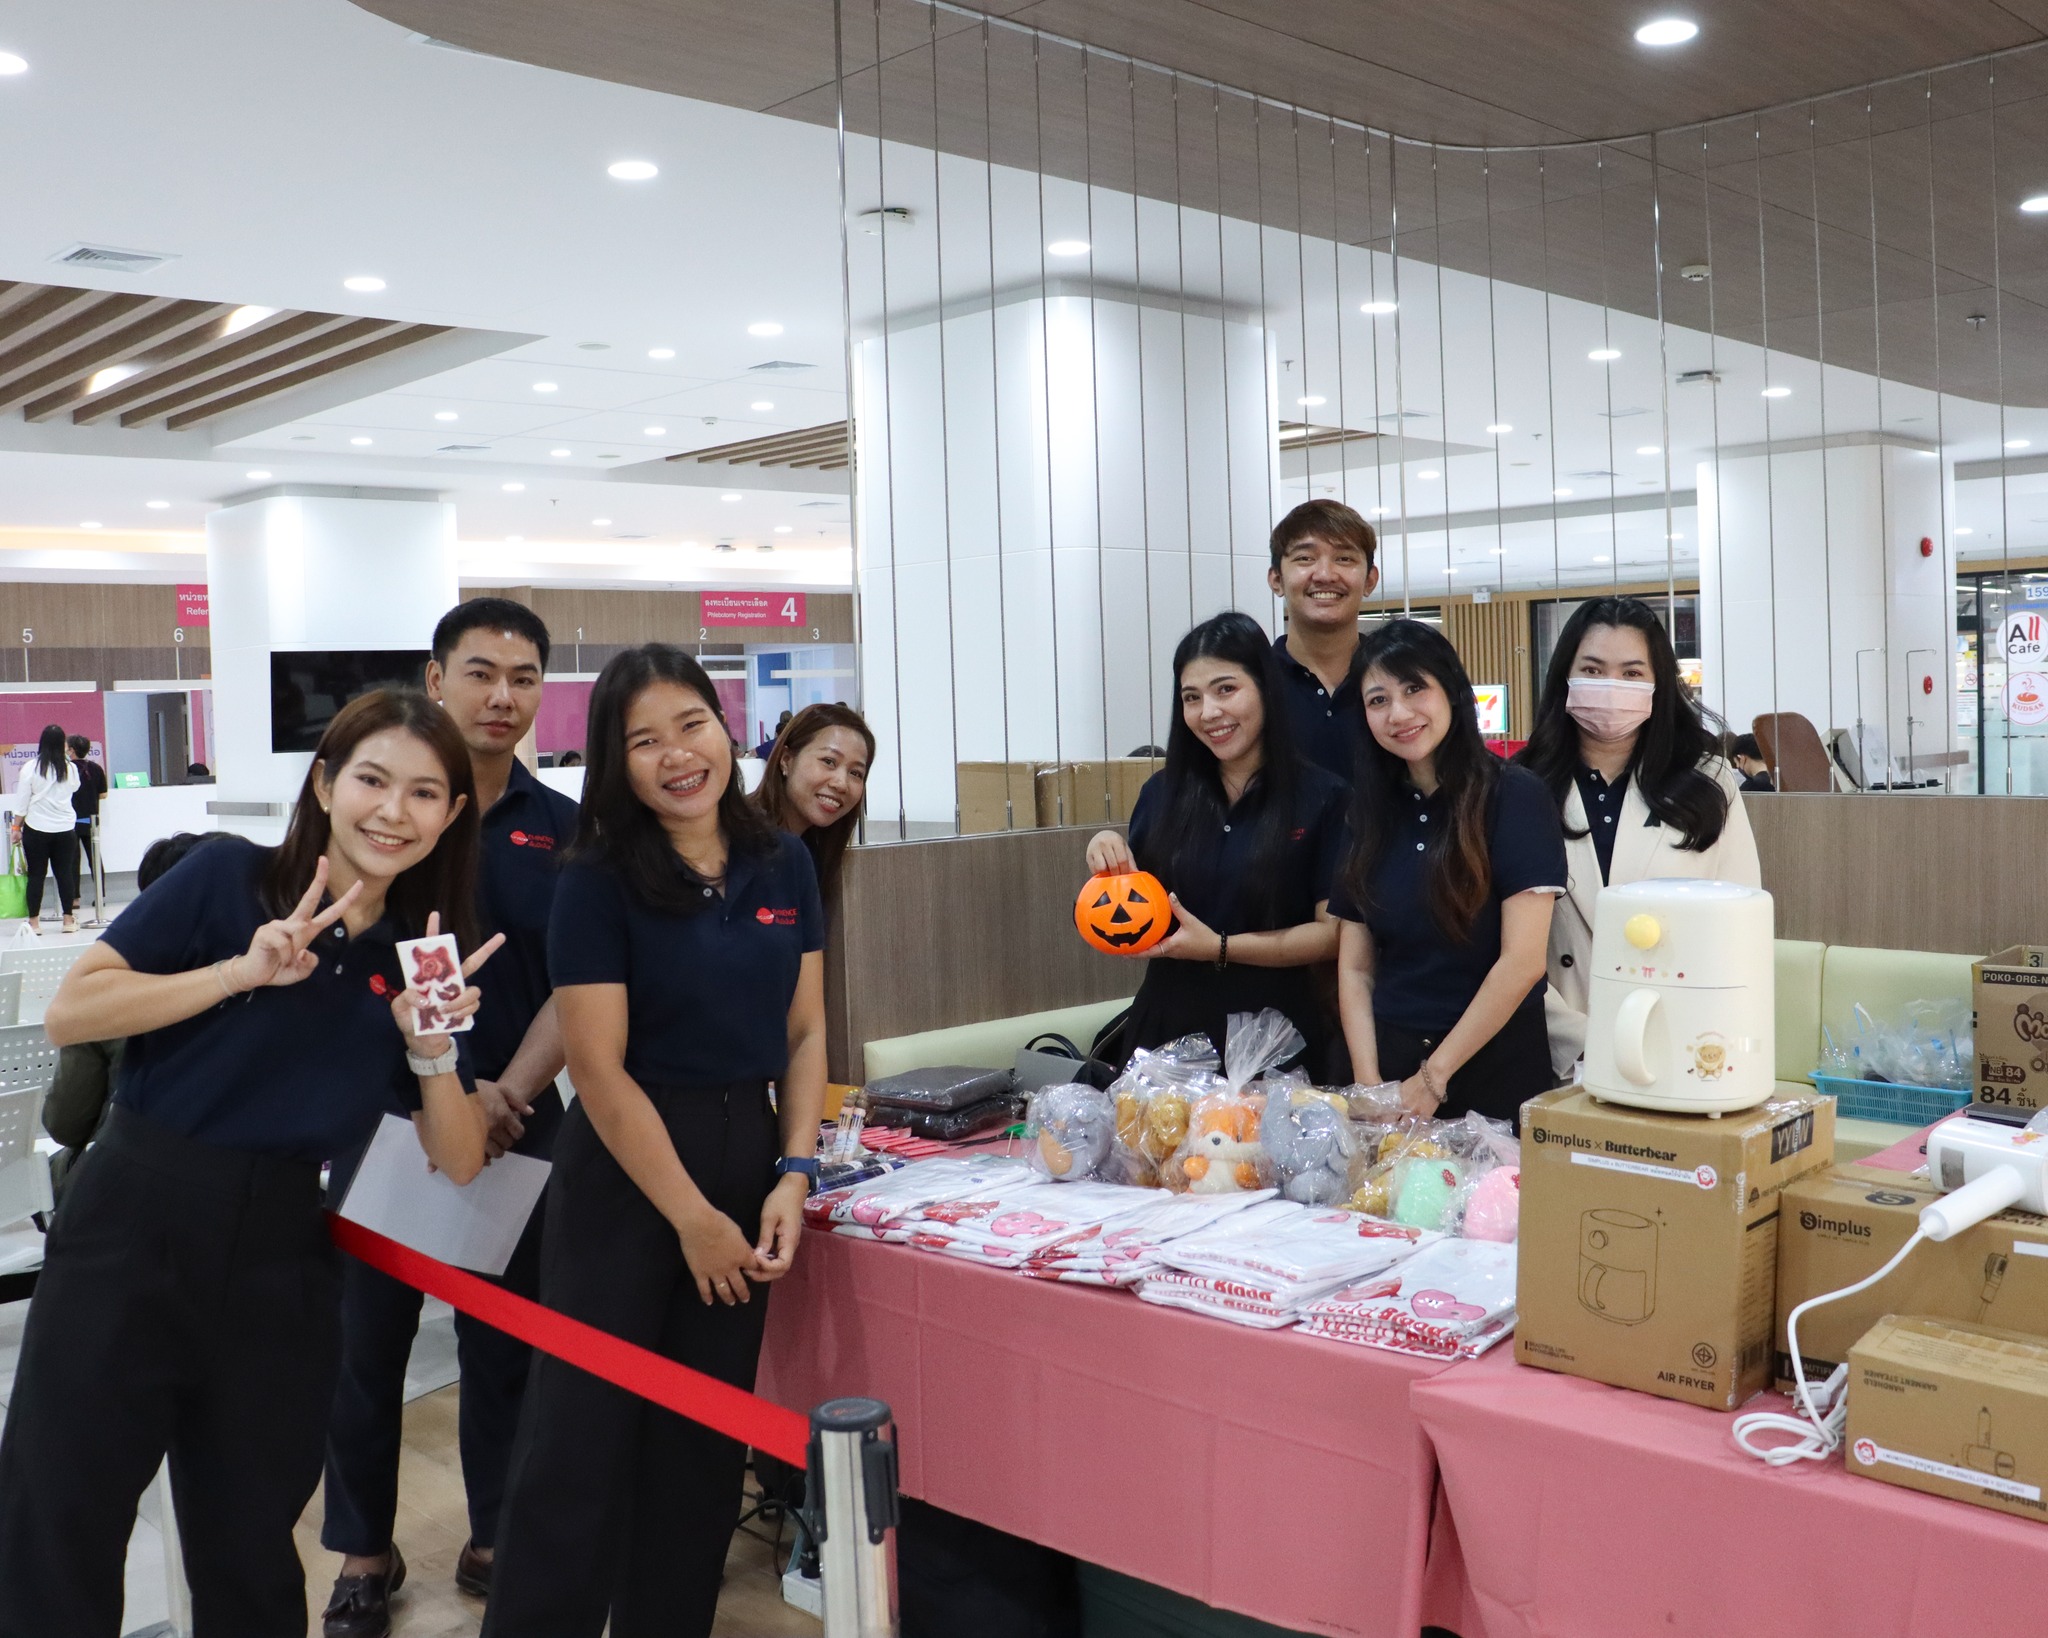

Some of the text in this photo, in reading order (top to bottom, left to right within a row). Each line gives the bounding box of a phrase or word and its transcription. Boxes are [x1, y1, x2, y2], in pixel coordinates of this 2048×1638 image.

[707, 611, 767, 619] Phlebotomy Registration
[780, 597, 799, 623] 4
[22, 628, 33, 643] 5
[173, 627, 184, 643] 6
[576, 627, 583, 640] 1
[699, 627, 707, 640] 2
[812, 628, 820, 640] 3
[2009, 616, 2040, 642] All
[2008, 642, 2041, 655] Café
[2005, 1067, 2021, 1078] 84
[1980, 1085, 2011, 1105] 84
[1533, 1127, 1592, 1149] Simplus
[1604, 1140, 1677, 1162] Butterbear
[1800, 1210, 1872, 1238] Simplus
[1657, 1371, 1676, 1384] AIR
[1679, 1375, 1715, 1392] FRYER
